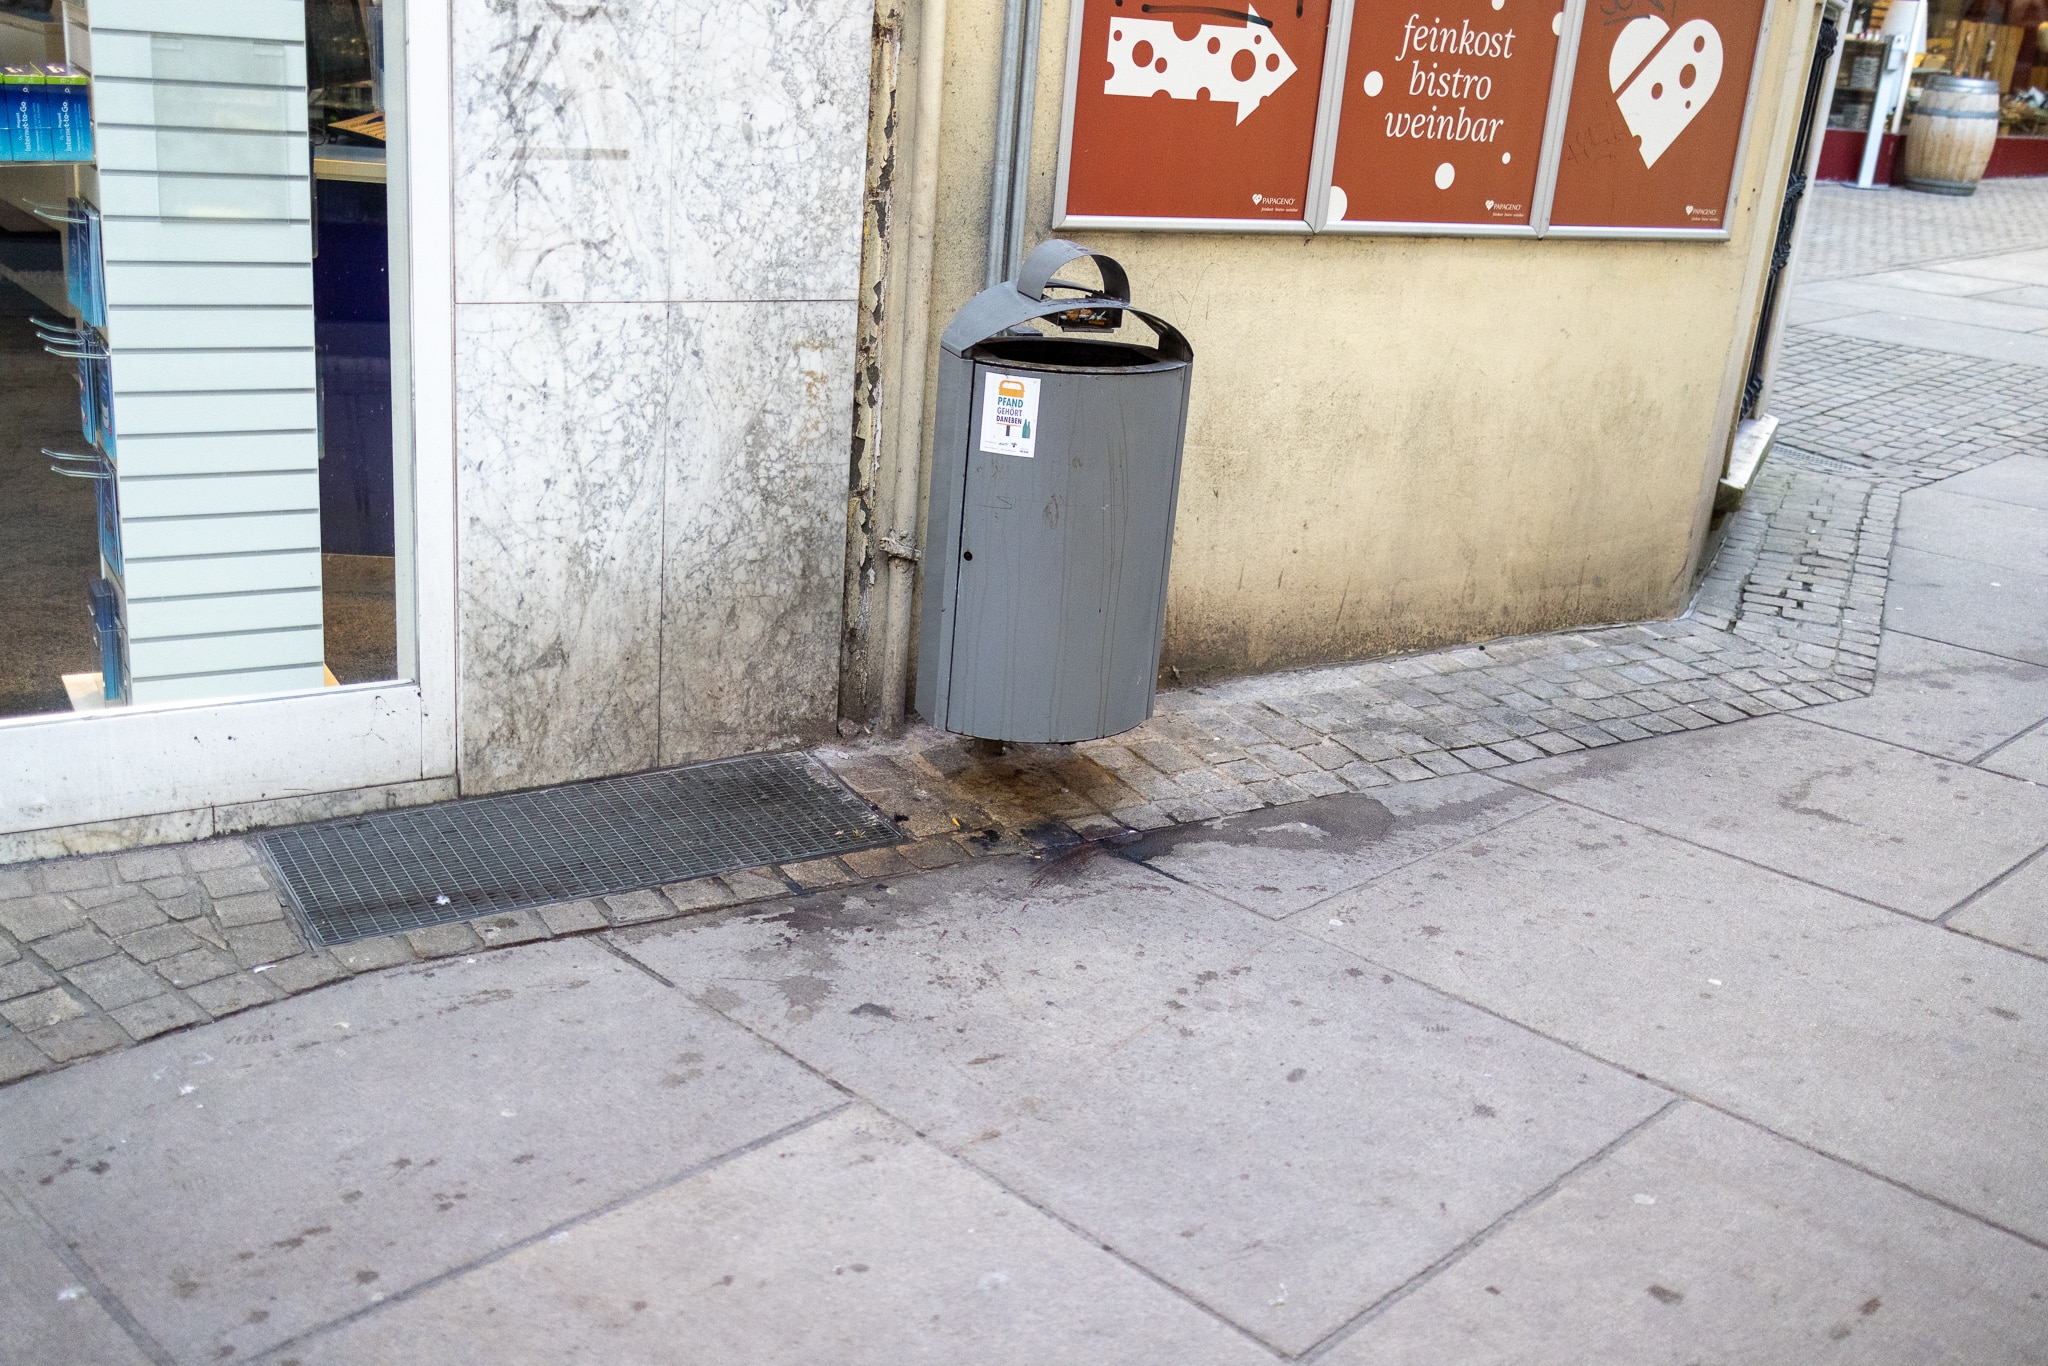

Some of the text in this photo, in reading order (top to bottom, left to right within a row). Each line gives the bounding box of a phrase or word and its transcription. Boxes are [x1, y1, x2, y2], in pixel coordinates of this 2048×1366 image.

[1395, 13, 1516, 61] feinkost
[1409, 60, 1492, 100] bistro
[1384, 105, 1504, 142] weinbar
[1262, 197, 1295, 205] PAPAGENO
[1493, 203, 1521, 211] PAPAGENO
[997, 396, 1024, 408] PFAND
[996, 406, 1023, 417] GEHÖRT
[996, 415, 1023, 425] DANEBEN
